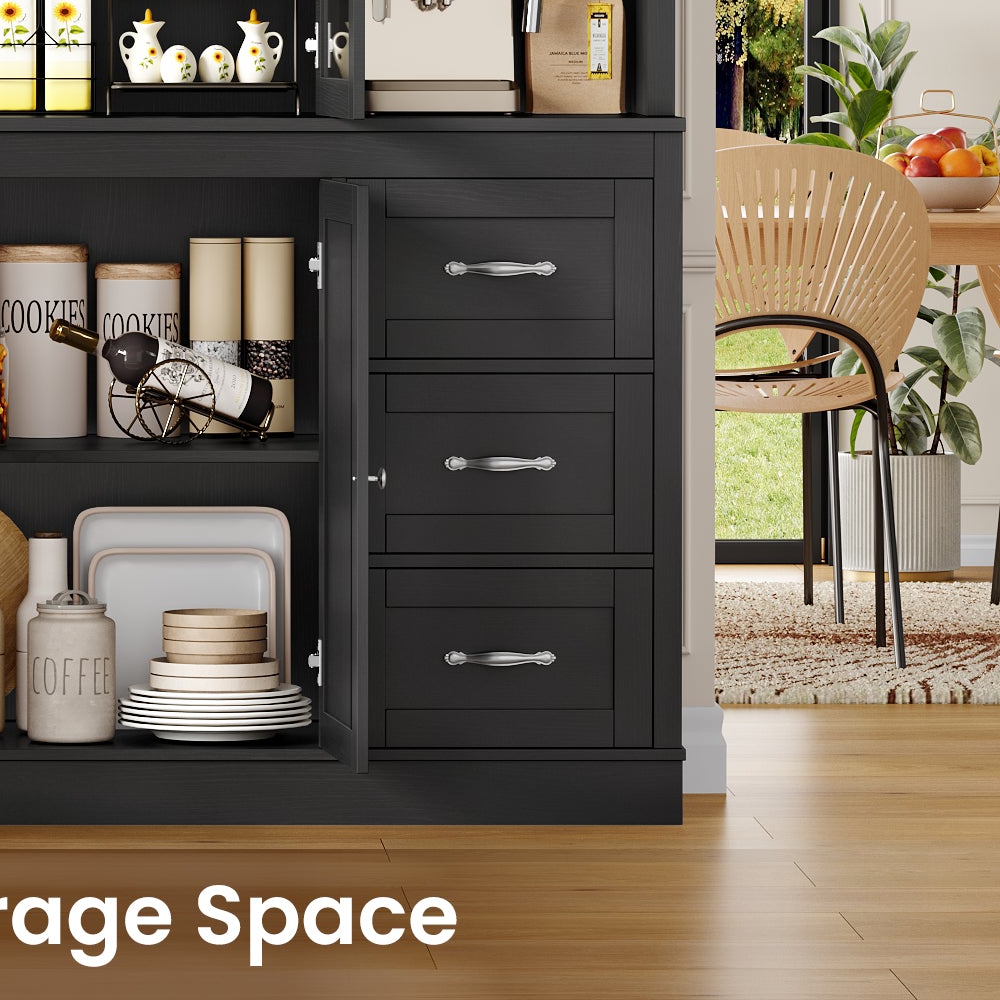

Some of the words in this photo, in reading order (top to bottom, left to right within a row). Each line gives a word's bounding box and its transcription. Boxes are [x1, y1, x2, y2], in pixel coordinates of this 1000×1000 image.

[1, 299, 85, 334] COOKIES
[103, 312, 180, 343] COOKIES
[32, 656, 111, 695] COFFEE
